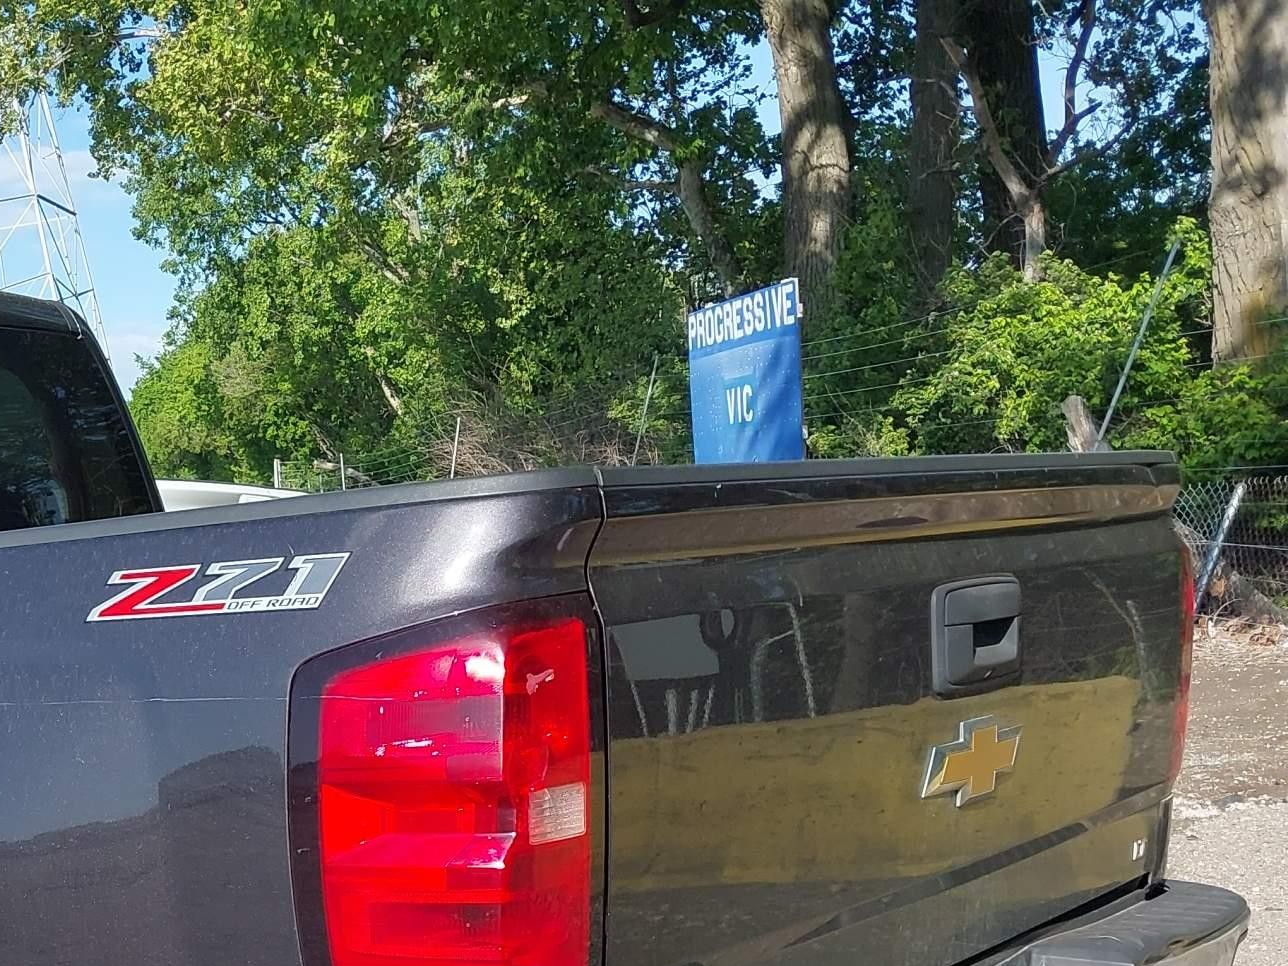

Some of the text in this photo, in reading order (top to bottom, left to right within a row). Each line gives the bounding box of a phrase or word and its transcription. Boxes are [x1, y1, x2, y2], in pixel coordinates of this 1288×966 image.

[688, 284, 796, 350] PROGRESSIVE
[726, 384, 754, 425] VIC
[86, 551, 353, 622] Z71
[227, 596, 320, 611] OFF ROAD
